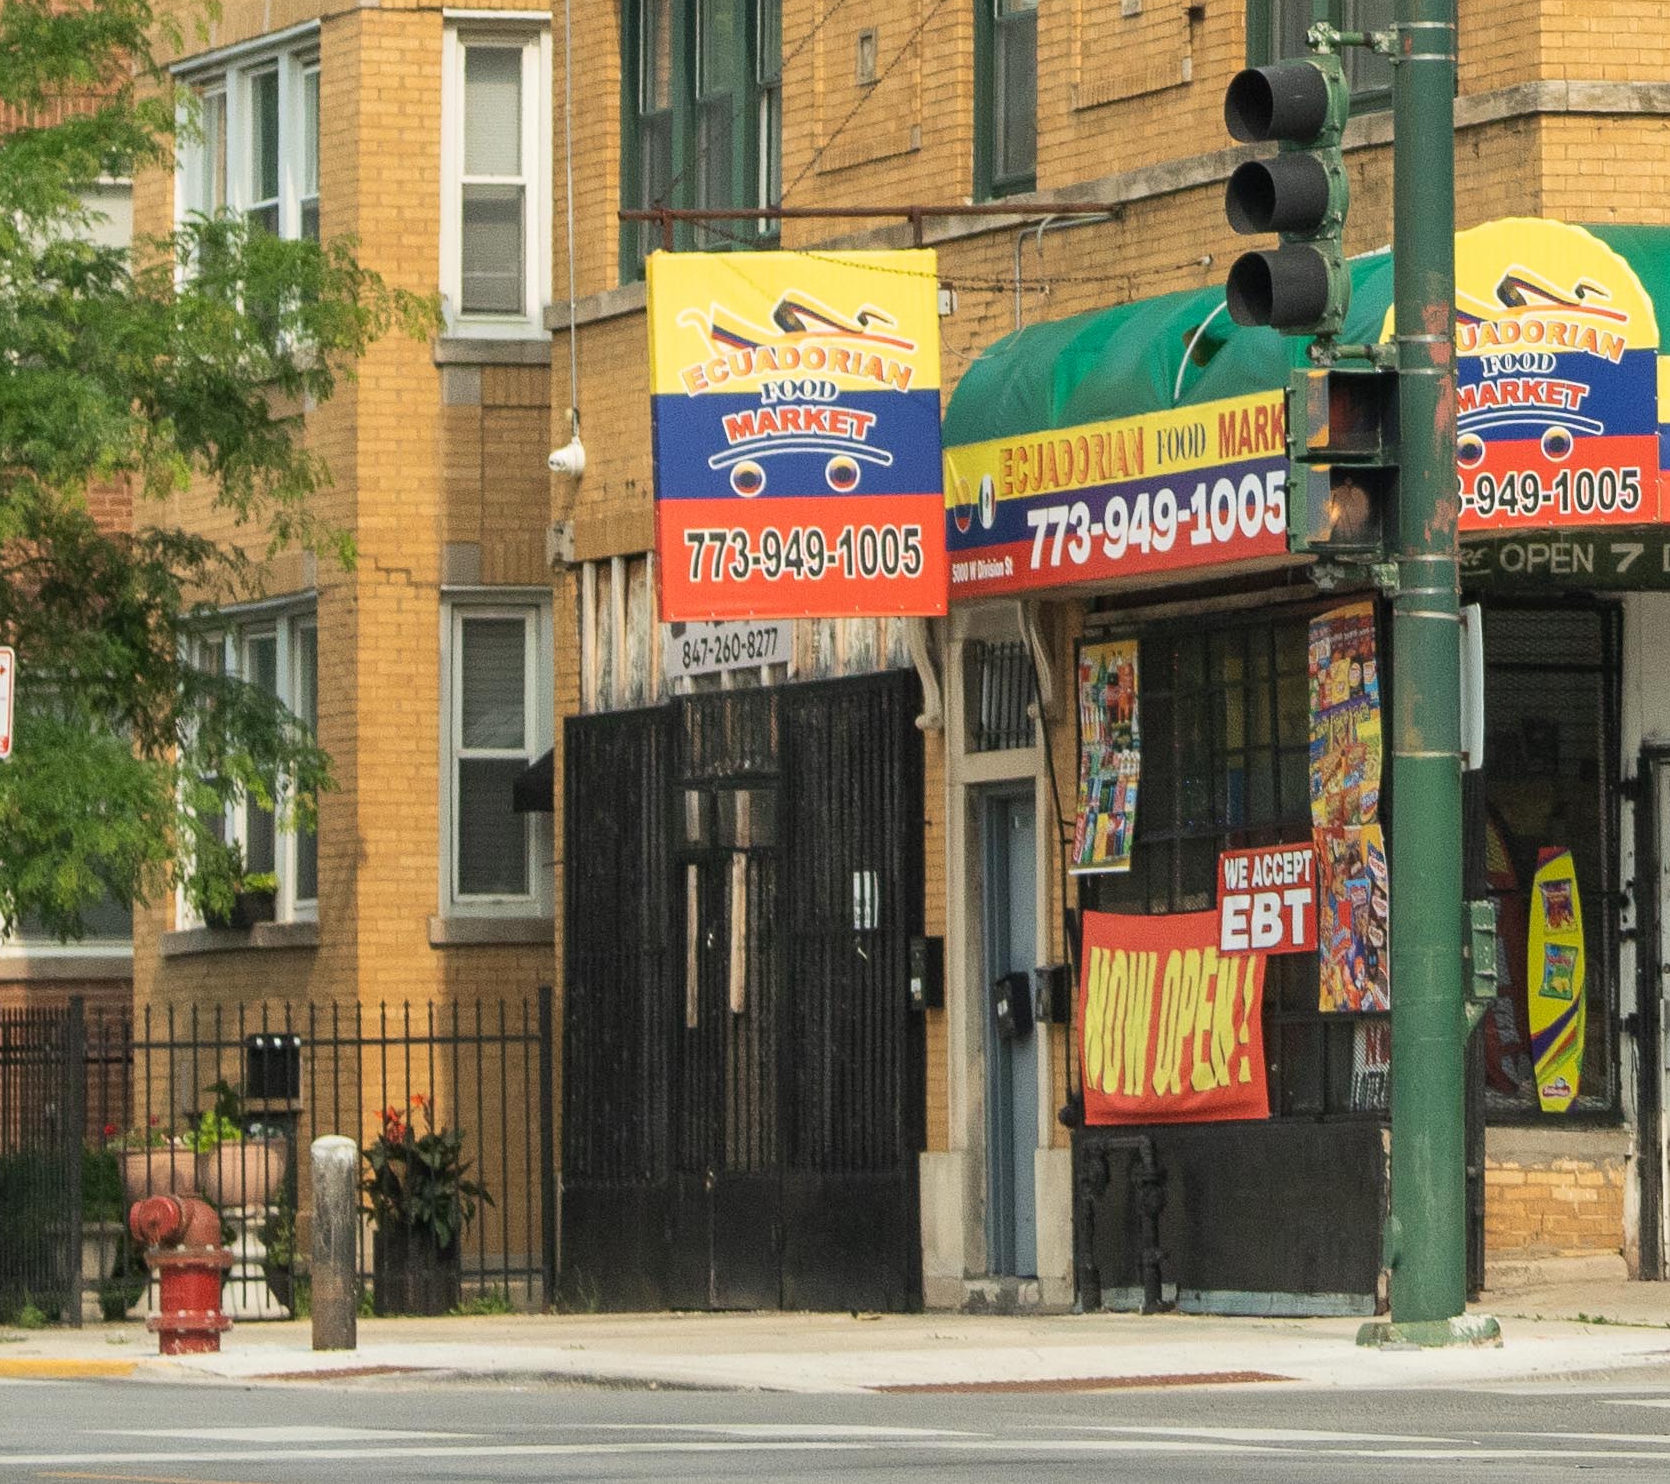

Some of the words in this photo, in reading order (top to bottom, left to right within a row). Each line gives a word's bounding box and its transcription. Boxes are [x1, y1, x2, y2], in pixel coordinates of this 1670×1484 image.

[1457, 320, 1627, 364] UADORIAN
[681, 346, 913, 394] ECUADORIAN
[1481, 352, 1556, 377] FOOD
[761, 378, 838, 404] FOOD
[1458, 377, 1590, 415] MARKET
[723, 405, 875, 444] MARKET
[998, 426, 1145, 498] ECUADORIAN
[1155, 422, 1207, 466] FOOD
[1217, 402, 1286, 460] MARK
[1027, 469, 1287, 570] 773-949-1005
[685, 525, 923, 581] 773-949-1005
[1499, 542, 1595, 574] OPEN
[1610, 542, 1645, 574] 7
[681, 626, 779, 669] 847-260-8277
[1224, 855, 1248, 890] WE
[1251, 849, 1313, 886] ACCEPT
[1220, 888, 1313, 952] EBT
[1085, 945, 1157, 1097] NOW
[1152, 944, 1256, 1095] OPEN!
